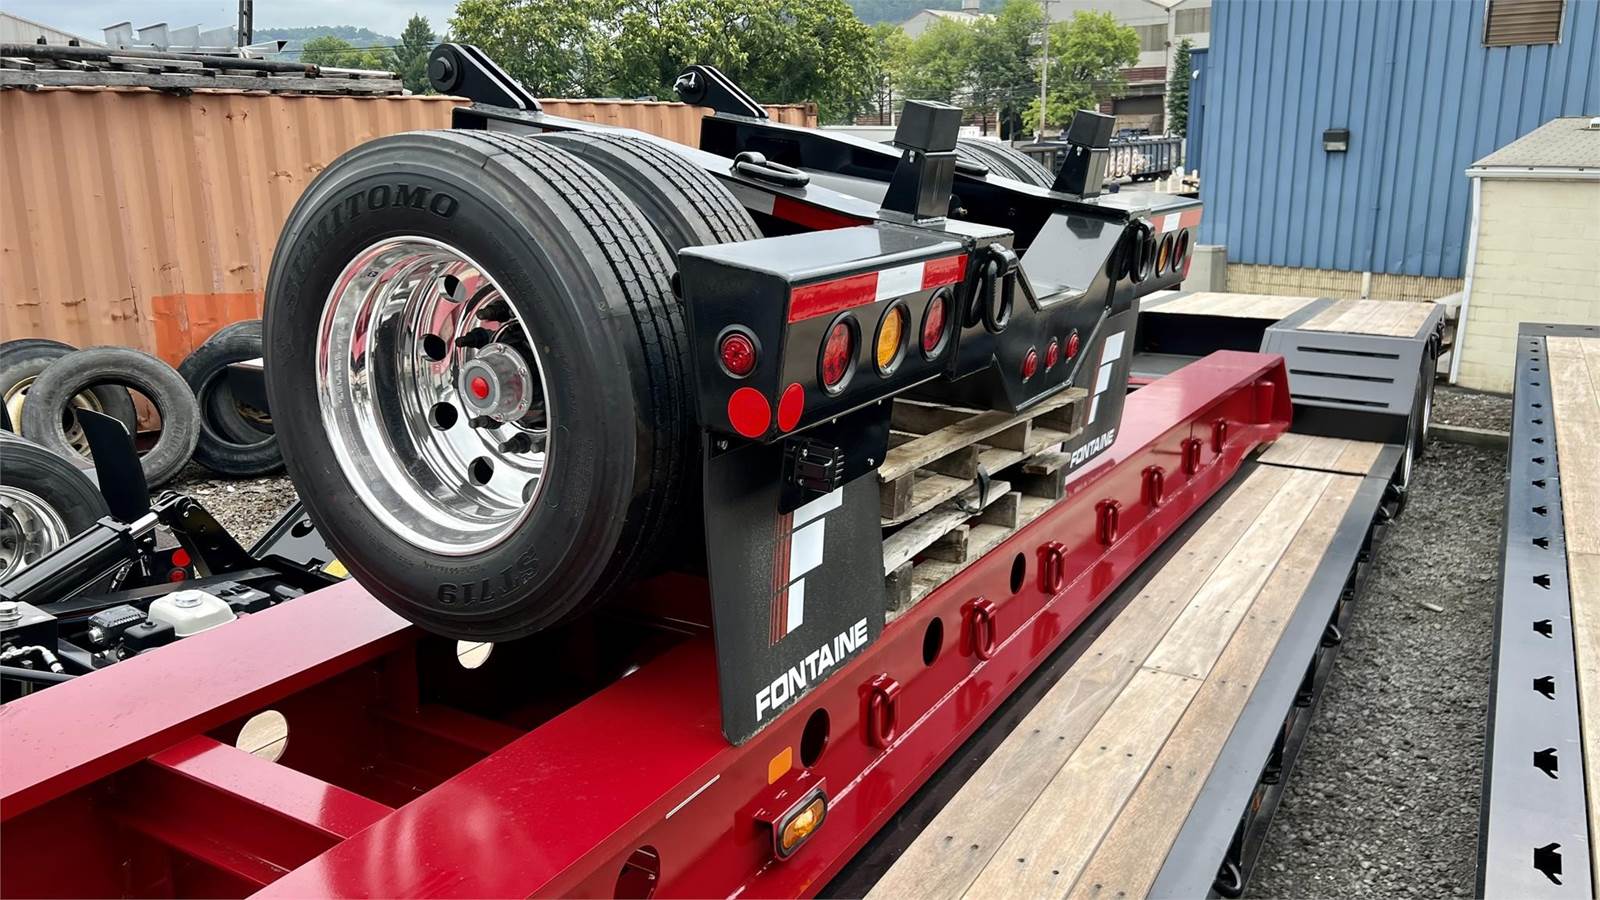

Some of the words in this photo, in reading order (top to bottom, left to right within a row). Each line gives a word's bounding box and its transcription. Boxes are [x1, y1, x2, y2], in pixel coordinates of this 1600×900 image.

[284, 185, 459, 309] SUMITOMO
[1070, 428, 1115, 468] FONTAINE
[438, 544, 539, 606] ST719
[755, 617, 868, 721] FONTAINE
